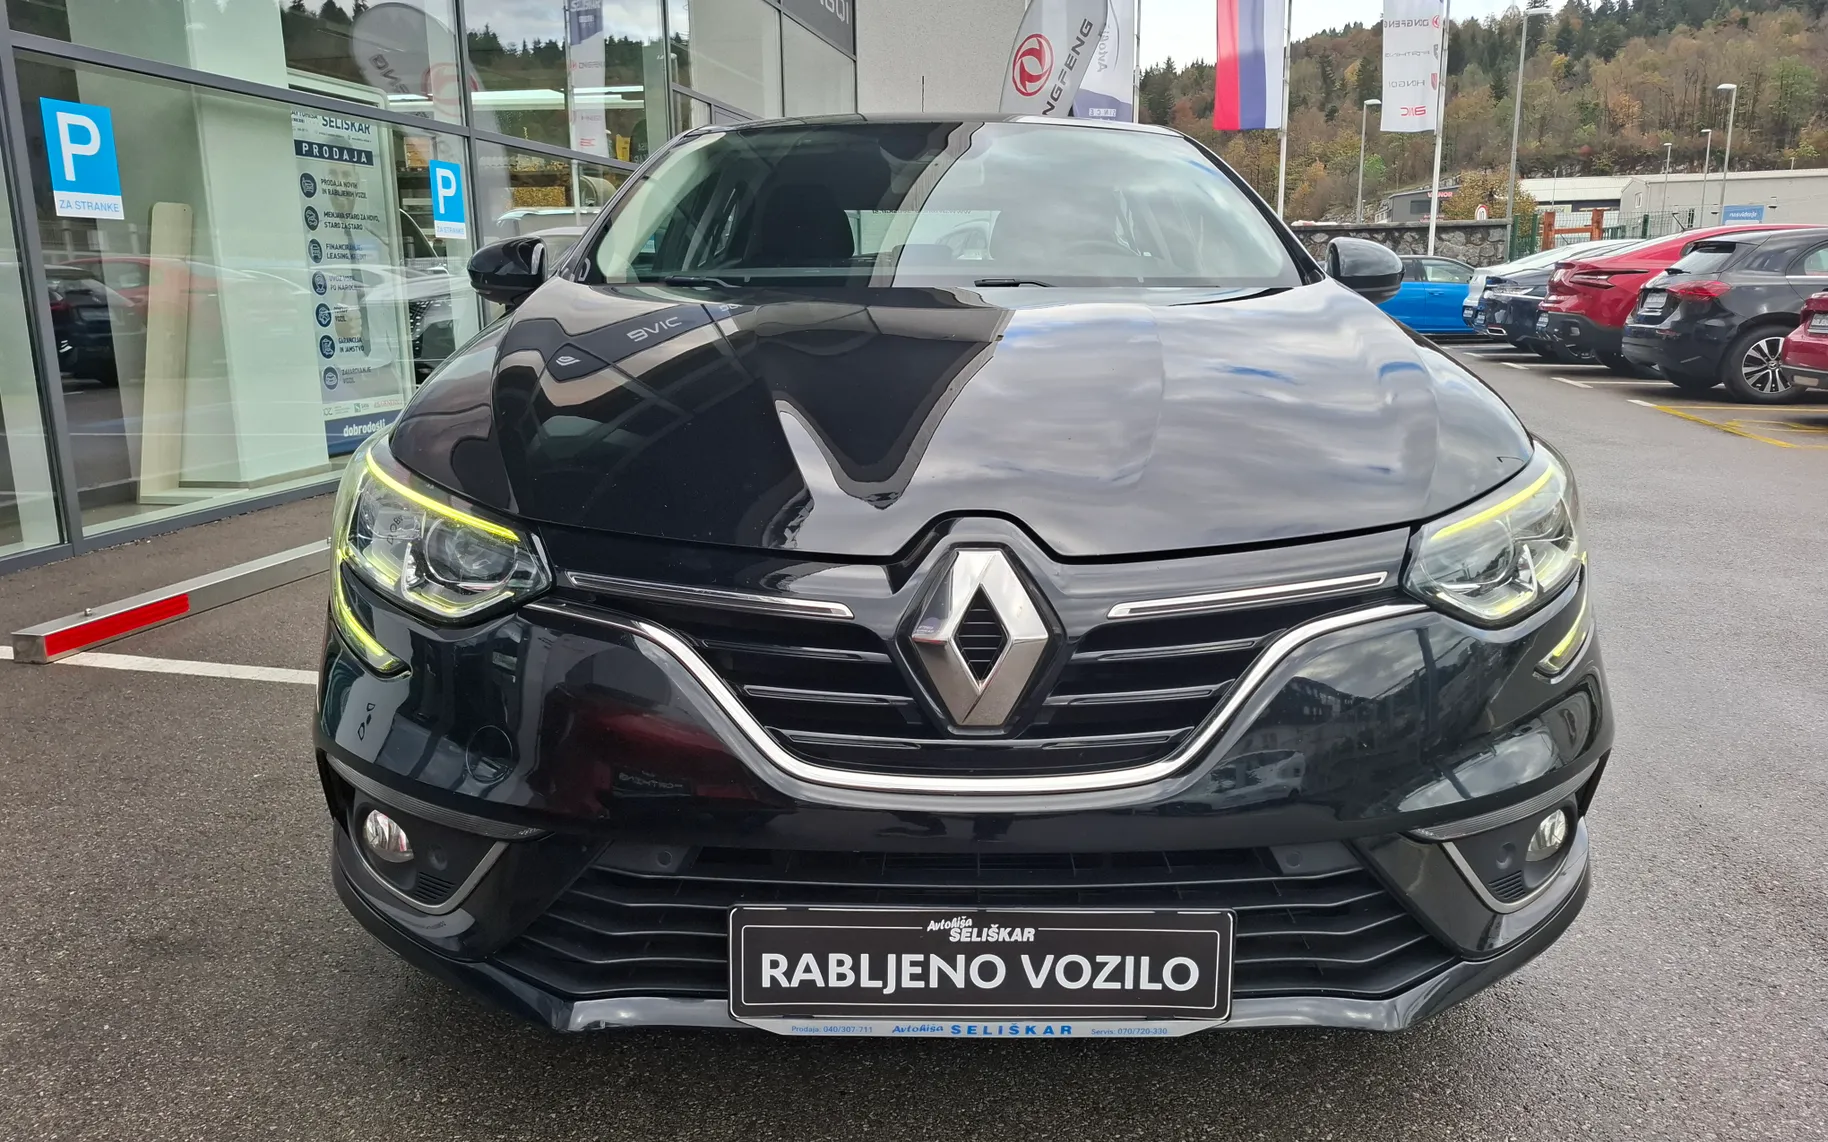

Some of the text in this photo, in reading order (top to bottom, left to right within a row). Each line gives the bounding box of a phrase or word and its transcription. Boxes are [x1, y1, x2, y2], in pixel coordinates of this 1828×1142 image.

[56, 111, 101, 182] P
[302, 142, 368, 164] PRODAJA
[436, 168, 457, 214] P
[60, 199, 120, 212] ZA STRANKE
[949, 923, 1036, 942] SELIŠKAR
[761, 953, 1200, 994] RABLJENO VOZILO
[791, 1025, 873, 1033] Prodaja: 040/307-711
[950, 1023, 1073, 1035] SELIŠKAR
[1117, 1027, 1168, 1035] 070/720-330
